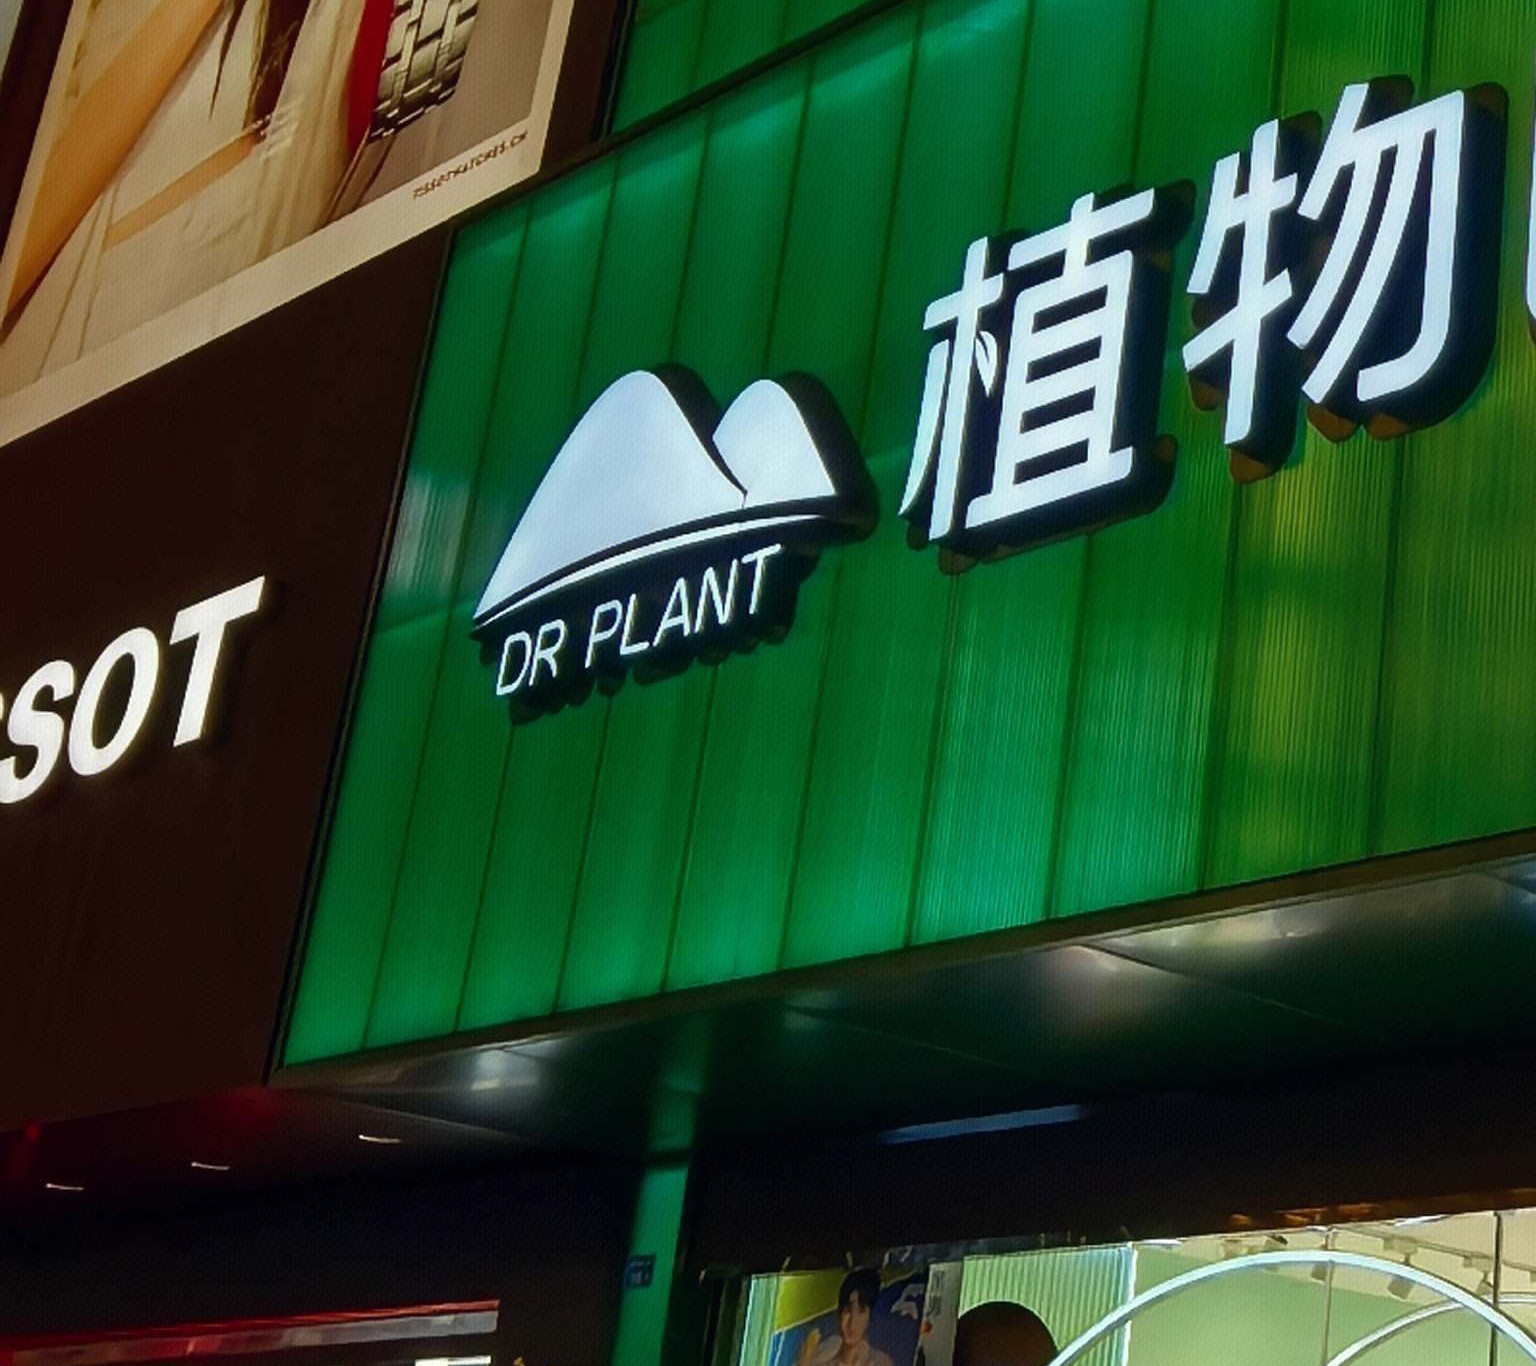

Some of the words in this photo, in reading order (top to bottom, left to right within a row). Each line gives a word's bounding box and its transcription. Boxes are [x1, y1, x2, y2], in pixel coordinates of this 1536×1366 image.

[0, 575, 265, 804] SOT
[495, 619, 568, 697] DR
[585, 543, 782, 667] PLANT
